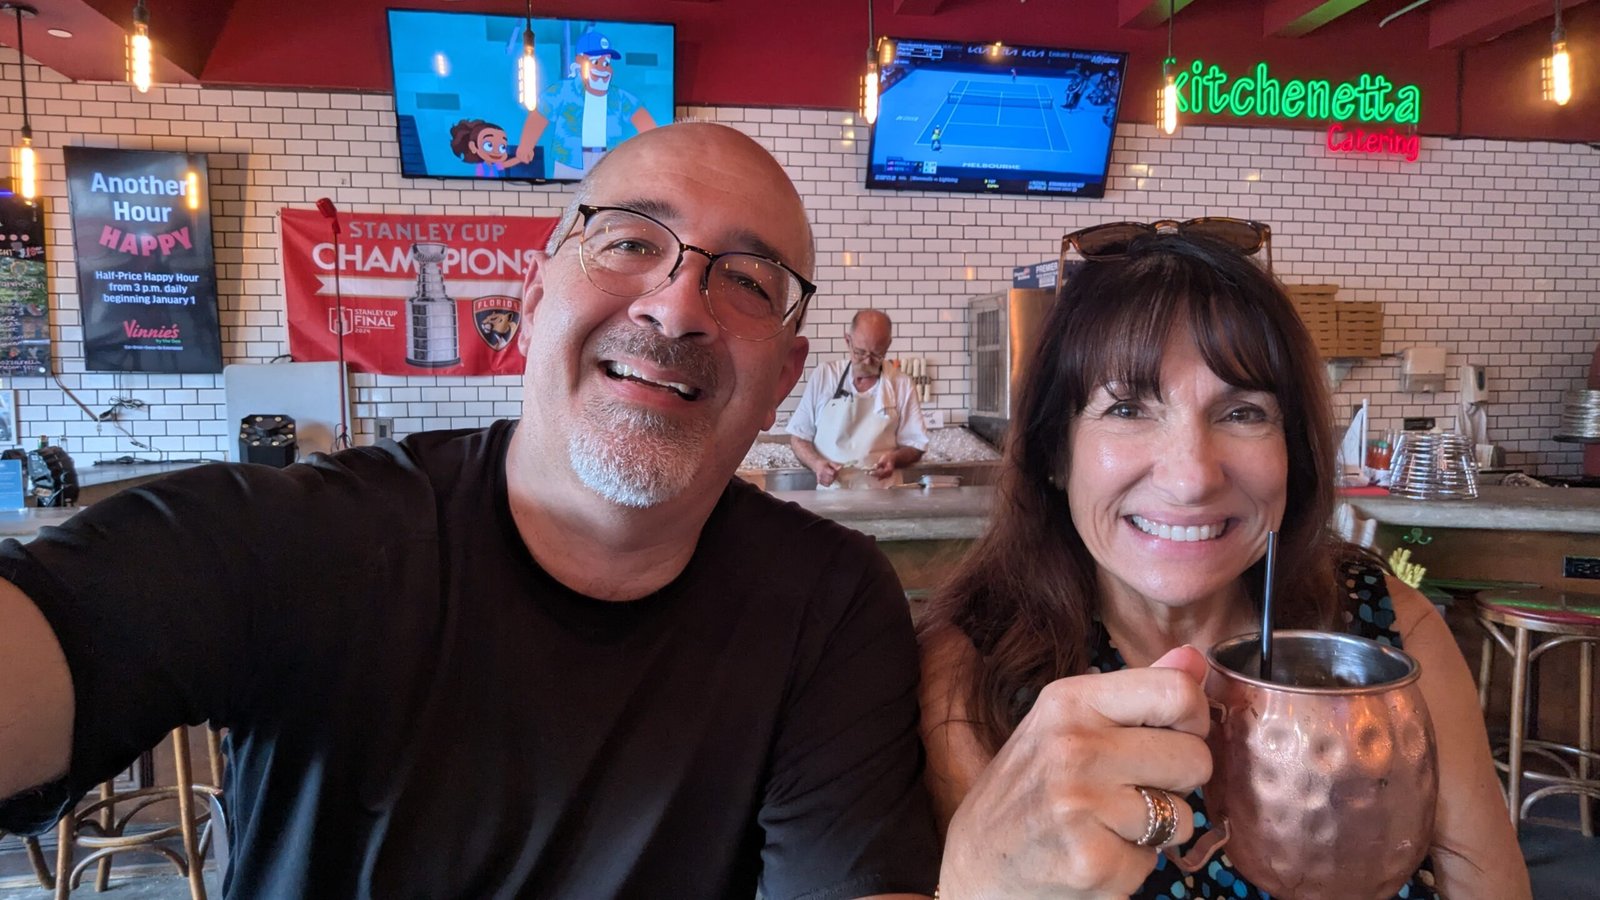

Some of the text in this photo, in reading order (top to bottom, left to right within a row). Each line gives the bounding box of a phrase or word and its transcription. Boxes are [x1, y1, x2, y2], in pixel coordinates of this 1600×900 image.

[1328, 123, 1421, 162] Catering
[91, 172, 189, 196] Another
[113, 201, 173, 223] Hour
[98, 224, 193, 257] HAPPY
[349, 221, 505, 243] STANLEY CUP
[95, 271, 200, 283] Half-Price Happy Hour
[109, 282, 188, 294] from 3 p.m. daily
[103, 294, 196, 306] beginning January 1
[354, 308, 384, 316] STANLEY
[354, 315, 395, 328] FINAL
[123, 319, 180, 339] Vinnie's
